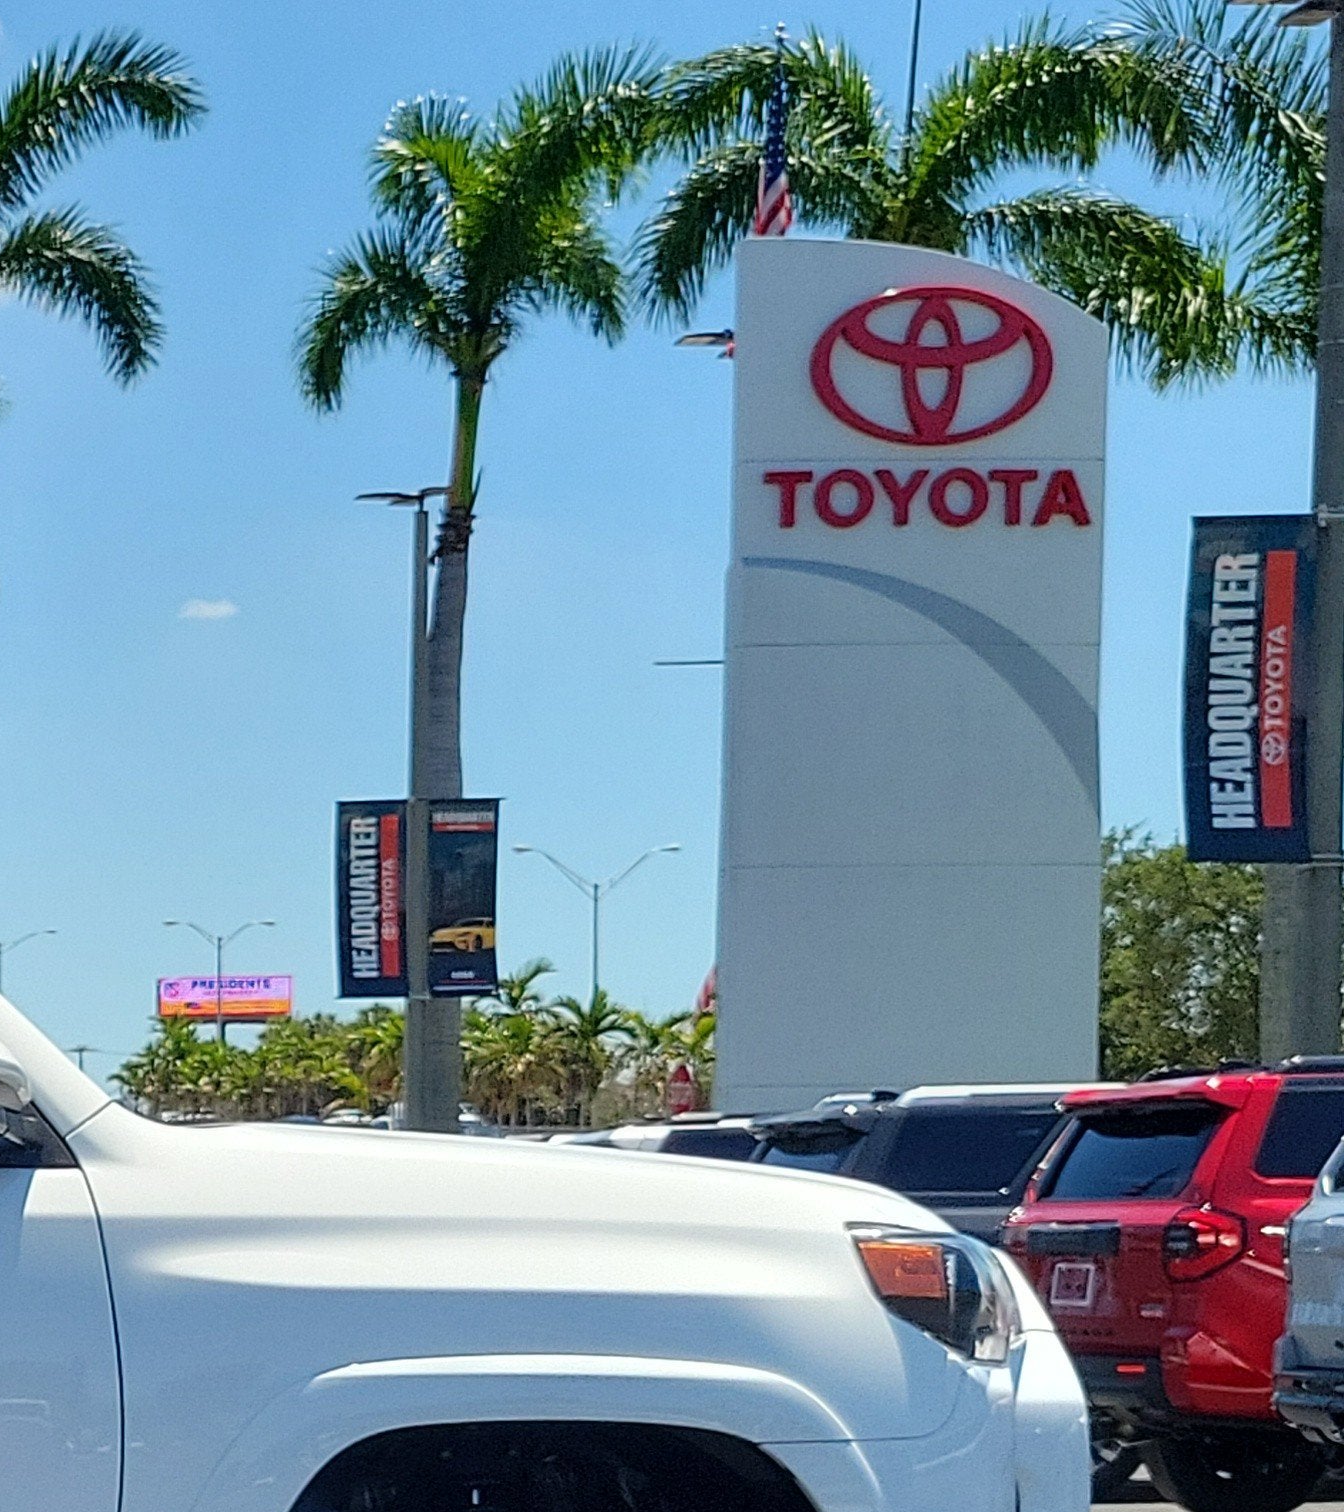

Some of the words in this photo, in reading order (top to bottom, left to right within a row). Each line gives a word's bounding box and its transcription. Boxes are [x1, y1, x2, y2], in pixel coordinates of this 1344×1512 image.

[763, 467, 1092, 529] TOYOTA
[1207, 552, 1260, 829] HEADQUARTER
[1264, 624, 1288, 728] TOYOTA
[349, 816, 380, 979] HEADQUARTER
[381, 857, 400, 920] TOYOTA
